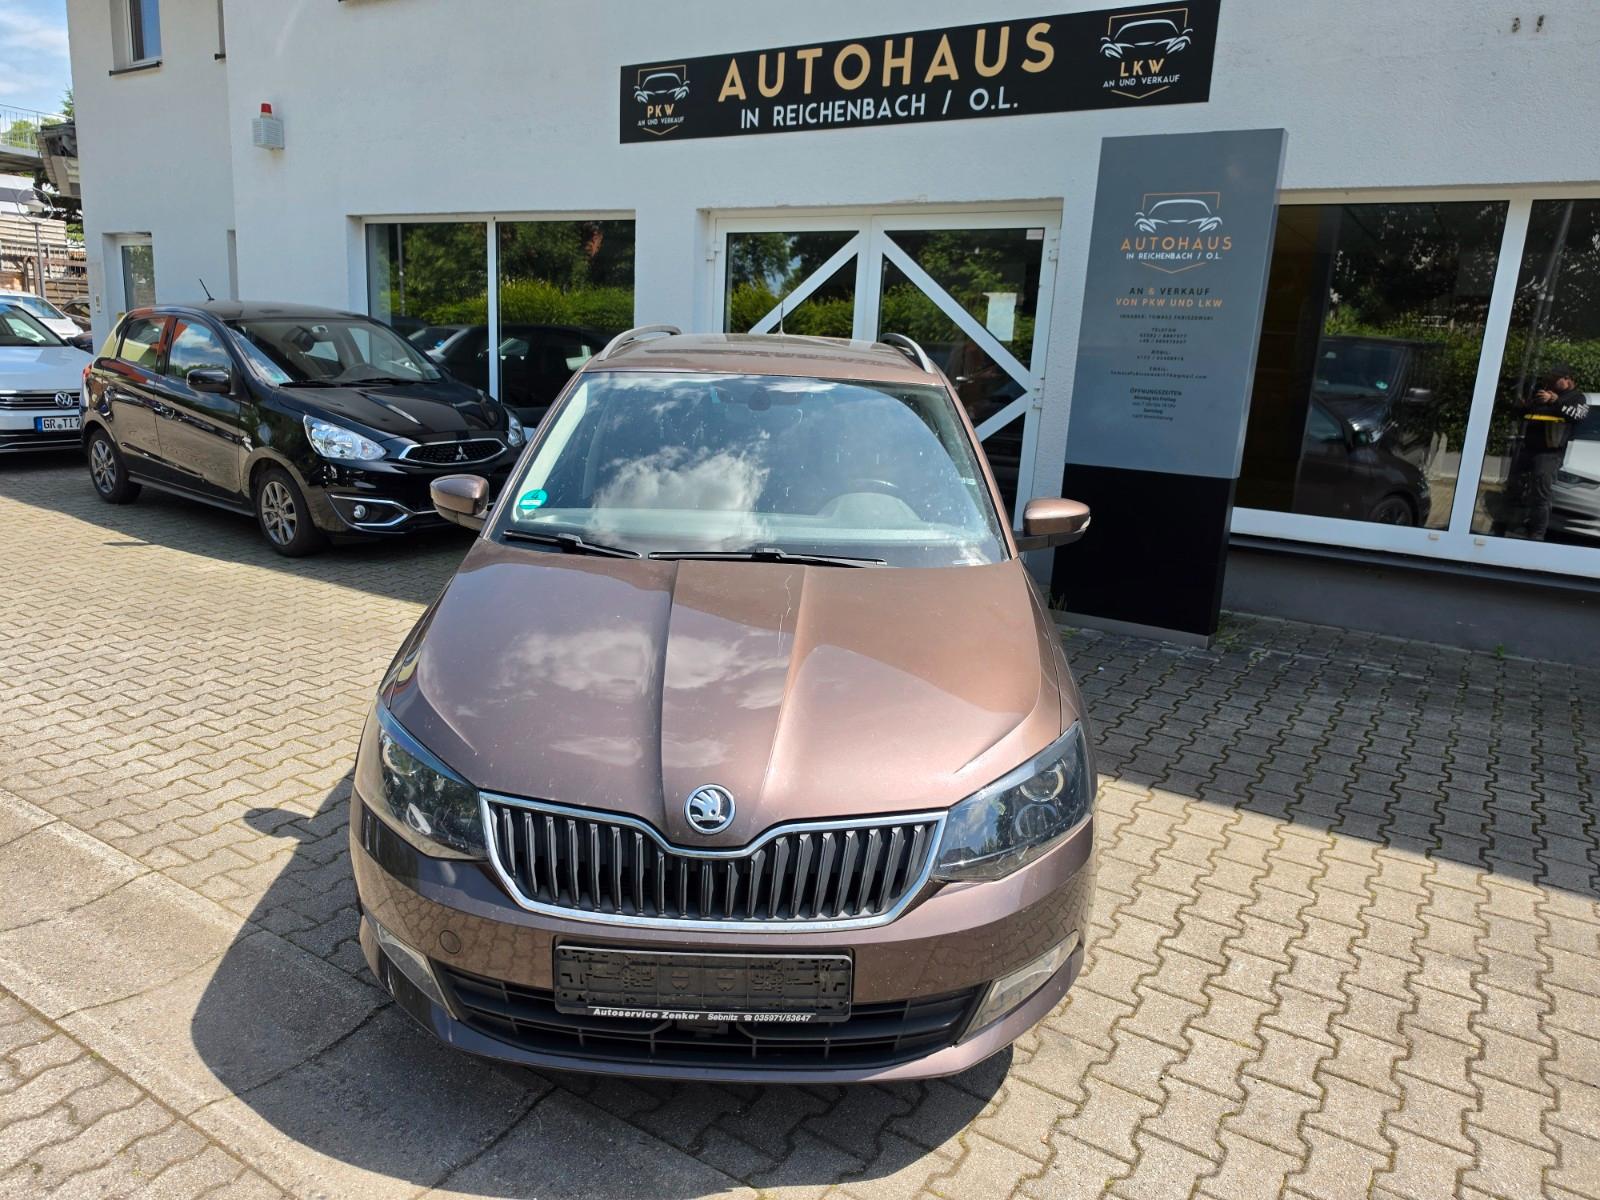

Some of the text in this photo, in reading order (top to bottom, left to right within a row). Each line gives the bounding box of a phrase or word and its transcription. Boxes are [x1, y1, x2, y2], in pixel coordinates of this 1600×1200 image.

[718, 22, 1055, 102] AUTOHAUS
[1120, 58, 1165, 77] LKW
[1102, 74, 1180, 88] AN UND VERKAUF
[647, 103, 675, 118] PKW
[740, 86, 1019, 129] IN REICHENBACH / O.L.
[647, 118, 658, 126] UND
[660, 116, 685, 125] VERKAUF
[1120, 236, 1233, 251] AUTOHAUS
[1126, 252, 1135, 260] IN
[1138, 252, 1193, 260] REICHENBACH
[1129, 287, 1144, 295] AN
[1160, 287, 1211, 296] VERKAUF
[1115, 297, 1223, 309] VON PKW UND LKW
[43, 418, 56, 429] GR
[593, 1008, 812, 1022] Autoservice Zenker Sebnitz 035971/53647
